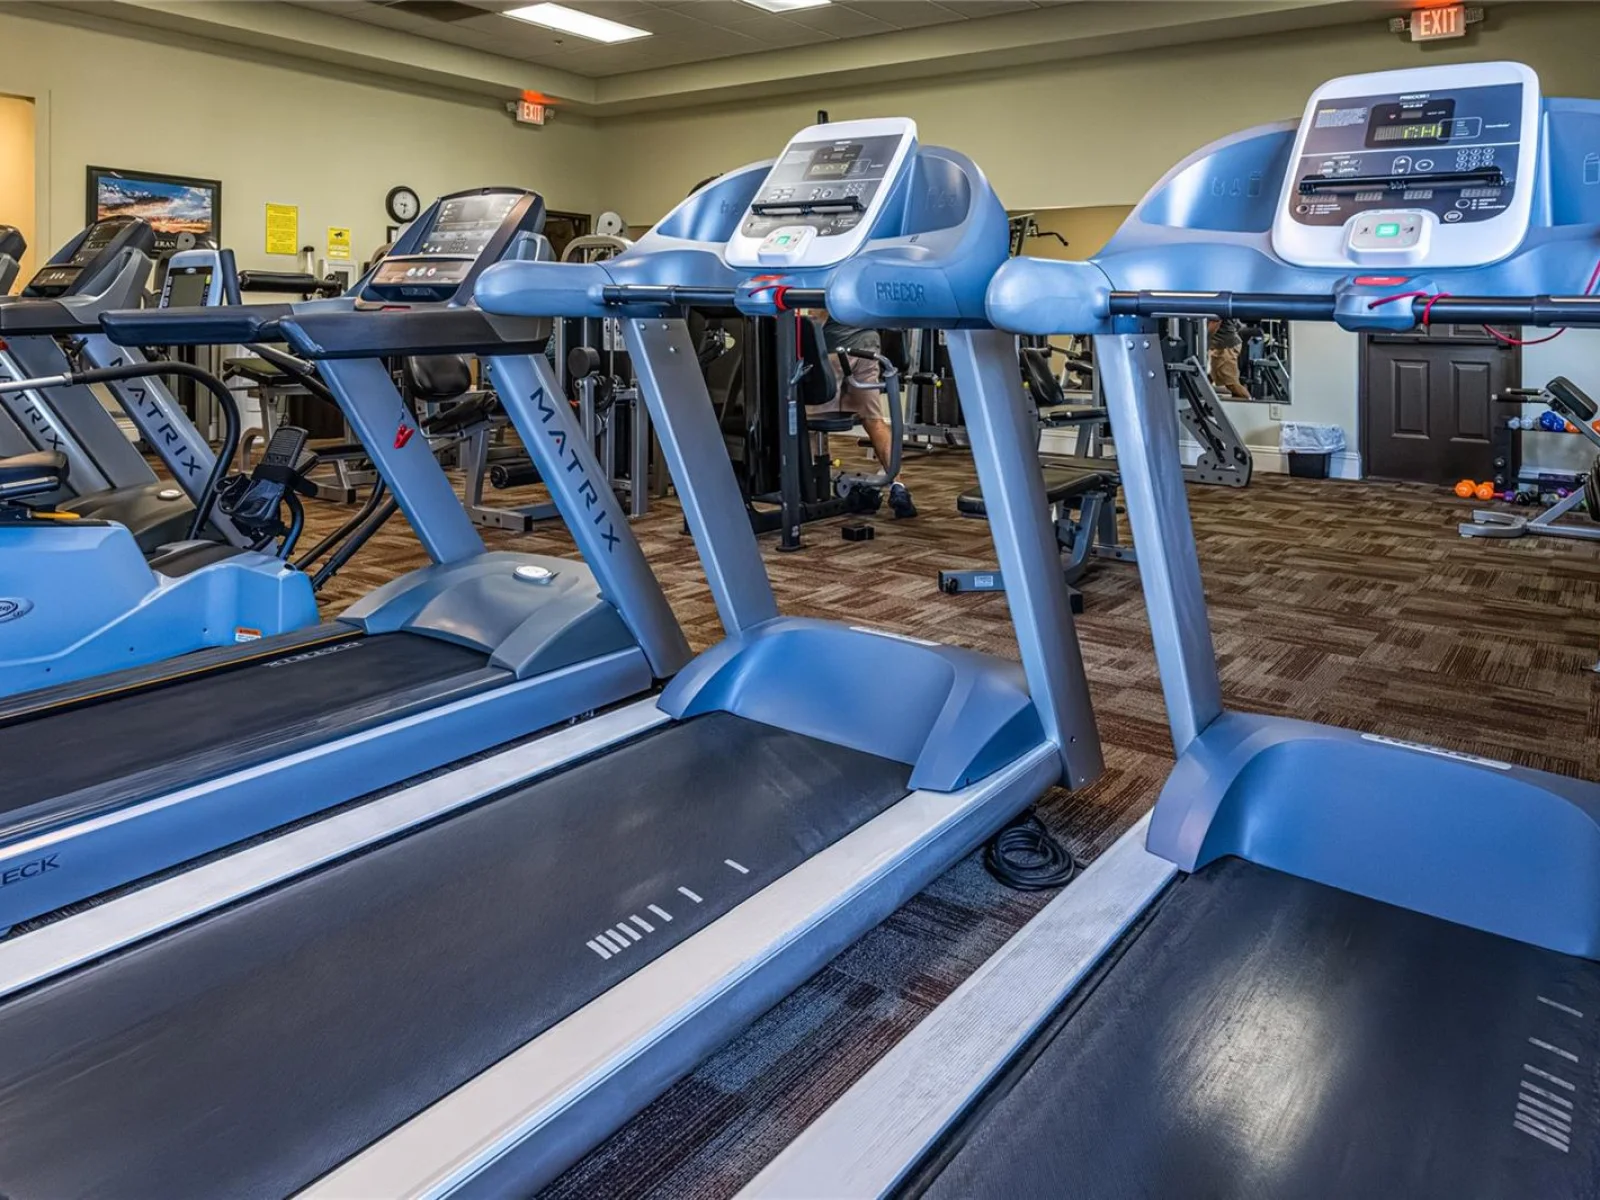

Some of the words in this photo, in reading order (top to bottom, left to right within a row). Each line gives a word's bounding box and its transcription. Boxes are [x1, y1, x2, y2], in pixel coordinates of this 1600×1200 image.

[1421, 8, 1458, 36] EXIT
[524, 102, 543, 122] EXIT
[530, 386, 621, 553] MATRIX
